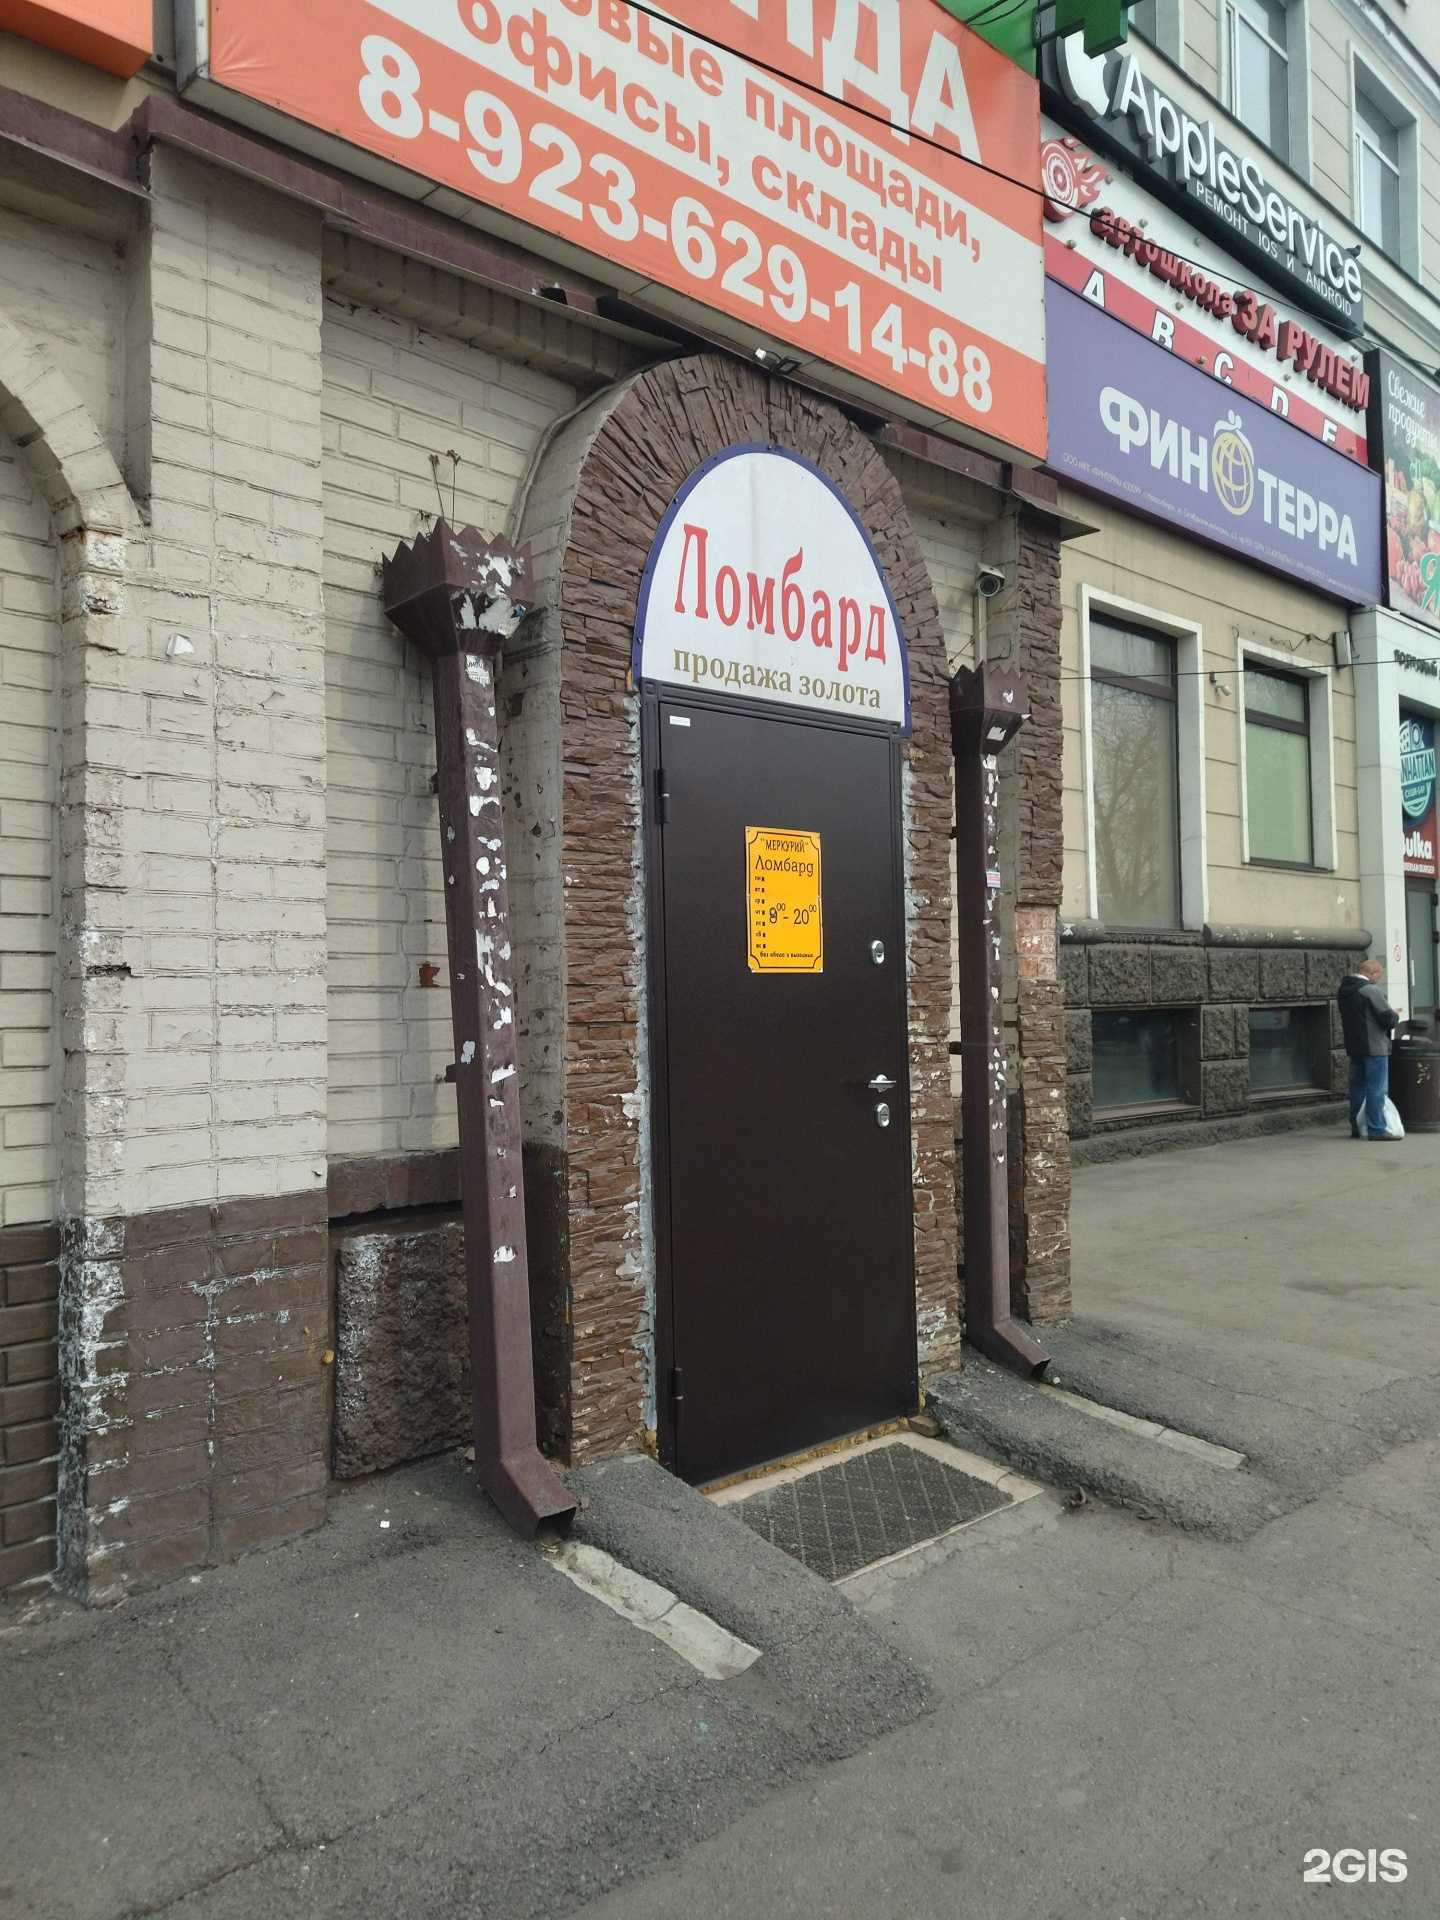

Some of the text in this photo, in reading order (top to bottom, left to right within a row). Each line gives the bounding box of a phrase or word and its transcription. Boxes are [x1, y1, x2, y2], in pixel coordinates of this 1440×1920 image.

[457, 0, 943, 293] офисы, склады
[730, 0, 982, 164] ДА
[358, 34, 993, 413] 8-923-629-14-88
[745, 78, 981, 263] площади,
[1114, 53, 1362, 303] AppleService
[1090, 206, 1234, 320] автошкола
[1232, 290, 1276, 350] ЗА
[1195, 182, 1249, 235] РЕМОНТ
[1305, 271, 1352, 316] ANDROID
[1388, 370, 1425, 418] Свежие
[674, 523, 887, 672] Ломбард
[673, 648, 881, 709] продажа золота
[1399, 751, 1434, 783] NHATTAN
[755, 855, 814, 877] Ломбард
